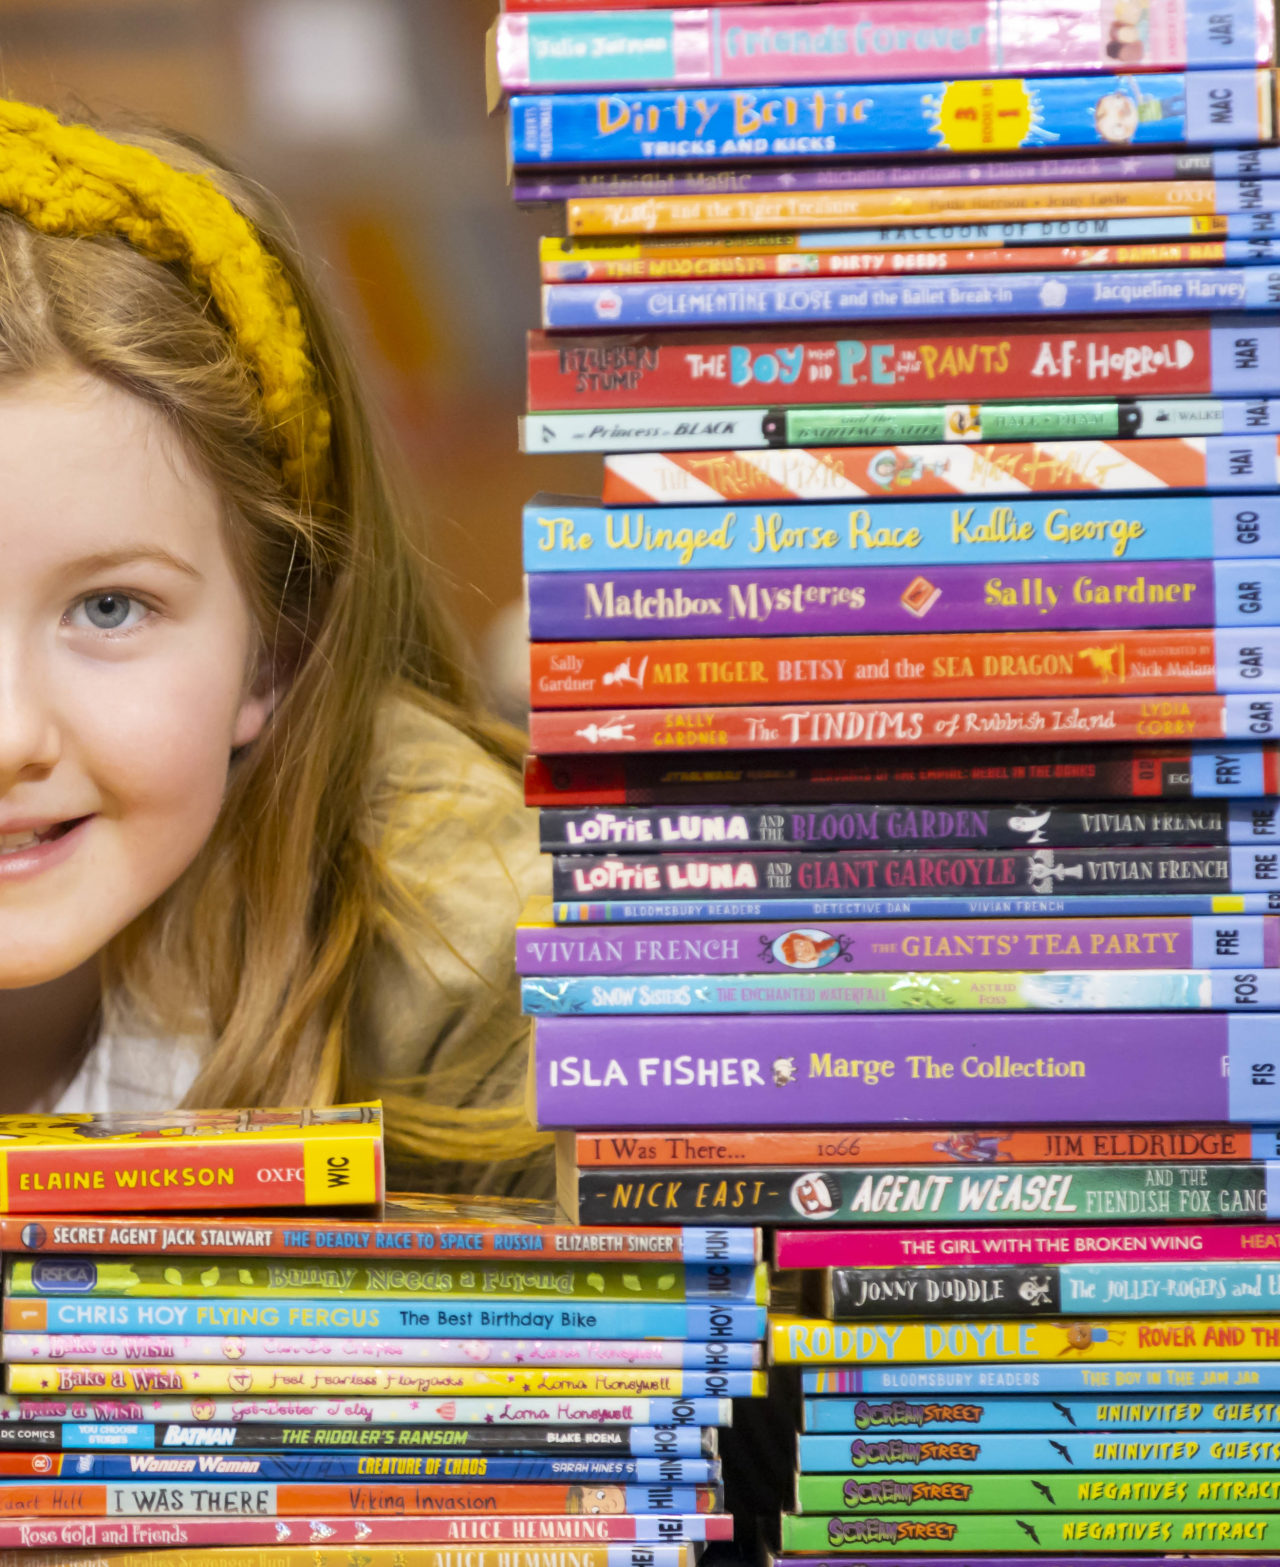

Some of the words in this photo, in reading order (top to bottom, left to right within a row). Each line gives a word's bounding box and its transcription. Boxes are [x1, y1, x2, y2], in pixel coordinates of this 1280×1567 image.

[641, 139, 716, 157] TRICKS
[722, 138, 768, 154] AND
[773, 136, 836, 153] KICKS
[538, 516, 593, 551] The
[605, 512, 736, 566] Winged
[749, 513, 840, 553] Horse
[848, 509, 923, 549] Race
[951, 506, 1036, 544] Kallie
[1044, 508, 1146, 557] George
[584, 582, 723, 619] Matchbox
[728, 583, 867, 621] Mysteries
[984, 575, 1064, 615] Sally
[1072, 575, 1198, 606] Gardner
[932, 657, 975, 679] SEA
[983, 654, 1075, 677] DRAGON
[659, 815, 750, 842] LUNA
[792, 813, 880, 841] BLOOM
[886, 811, 990, 839] GARDEN
[1081, 813, 1146, 834] VIVIAN
[1151, 811, 1223, 833] FRENCH
[1025, 934, 1084, 955] TEA
[1089, 932, 1180, 955] PARTY
[1215, 929, 1240, 956] FRE
[549, 1056, 629, 1088] ISLA
[638, 1055, 766, 1088] FISHER
[808, 1053, 897, 1086] Marge
[906, 1055, 954, 1079] The
[961, 1055, 1087, 1079] Collection
[817, 1137, 862, 1157] 1066
[1044, 1135, 1084, 1157] JIM
[1093, 1134, 1237, 1156] ELDRIDGE
[20, 1170, 105, 1192] ELAINE
[114, 1166, 235, 1188] WICKSON
[326, 1155, 351, 1188] WIC
[612, 1182, 682, 1209] NICK
[695, 1181, 766, 1208] EAST
[283, 1230, 311, 1247] THE
[315, 1231, 373, 1249] DEADLY
[375, 1232, 413, 1249] RACE
[417, 1233, 435, 1249] TO
[440, 1233, 483, 1250] SPACE
[493, 1235, 544, 1252] RUSSIA
[1074, 1236, 1148, 1253] BROKEN
[1151, 1235, 1204, 1251] WING
[855, 1279, 918, 1307] JONNY
[926, 1278, 1006, 1301] DUDDLE
[57, 1305, 129, 1325] CHRIS
[138, 1306, 188, 1325] HOY
[197, 1306, 280, 1326] FLYING
[289, 1308, 380, 1328] FERGUS
[400, 1311, 430, 1327] The
[437, 1312, 473, 1327] Best
[481, 1311, 555, 1332] Birthday
[561, 1312, 598, 1328] Bike
[788, 1324, 904, 1360] RODDY
[923, 1323, 1040, 1358] DOYLE
[448, 1521, 502, 1540] ALICE
[511, 1521, 610, 1540] HEMMING
[1062, 1522, 1173, 1543] NEGATIVES
[1182, 1521, 1269, 1541] ATTRACT
